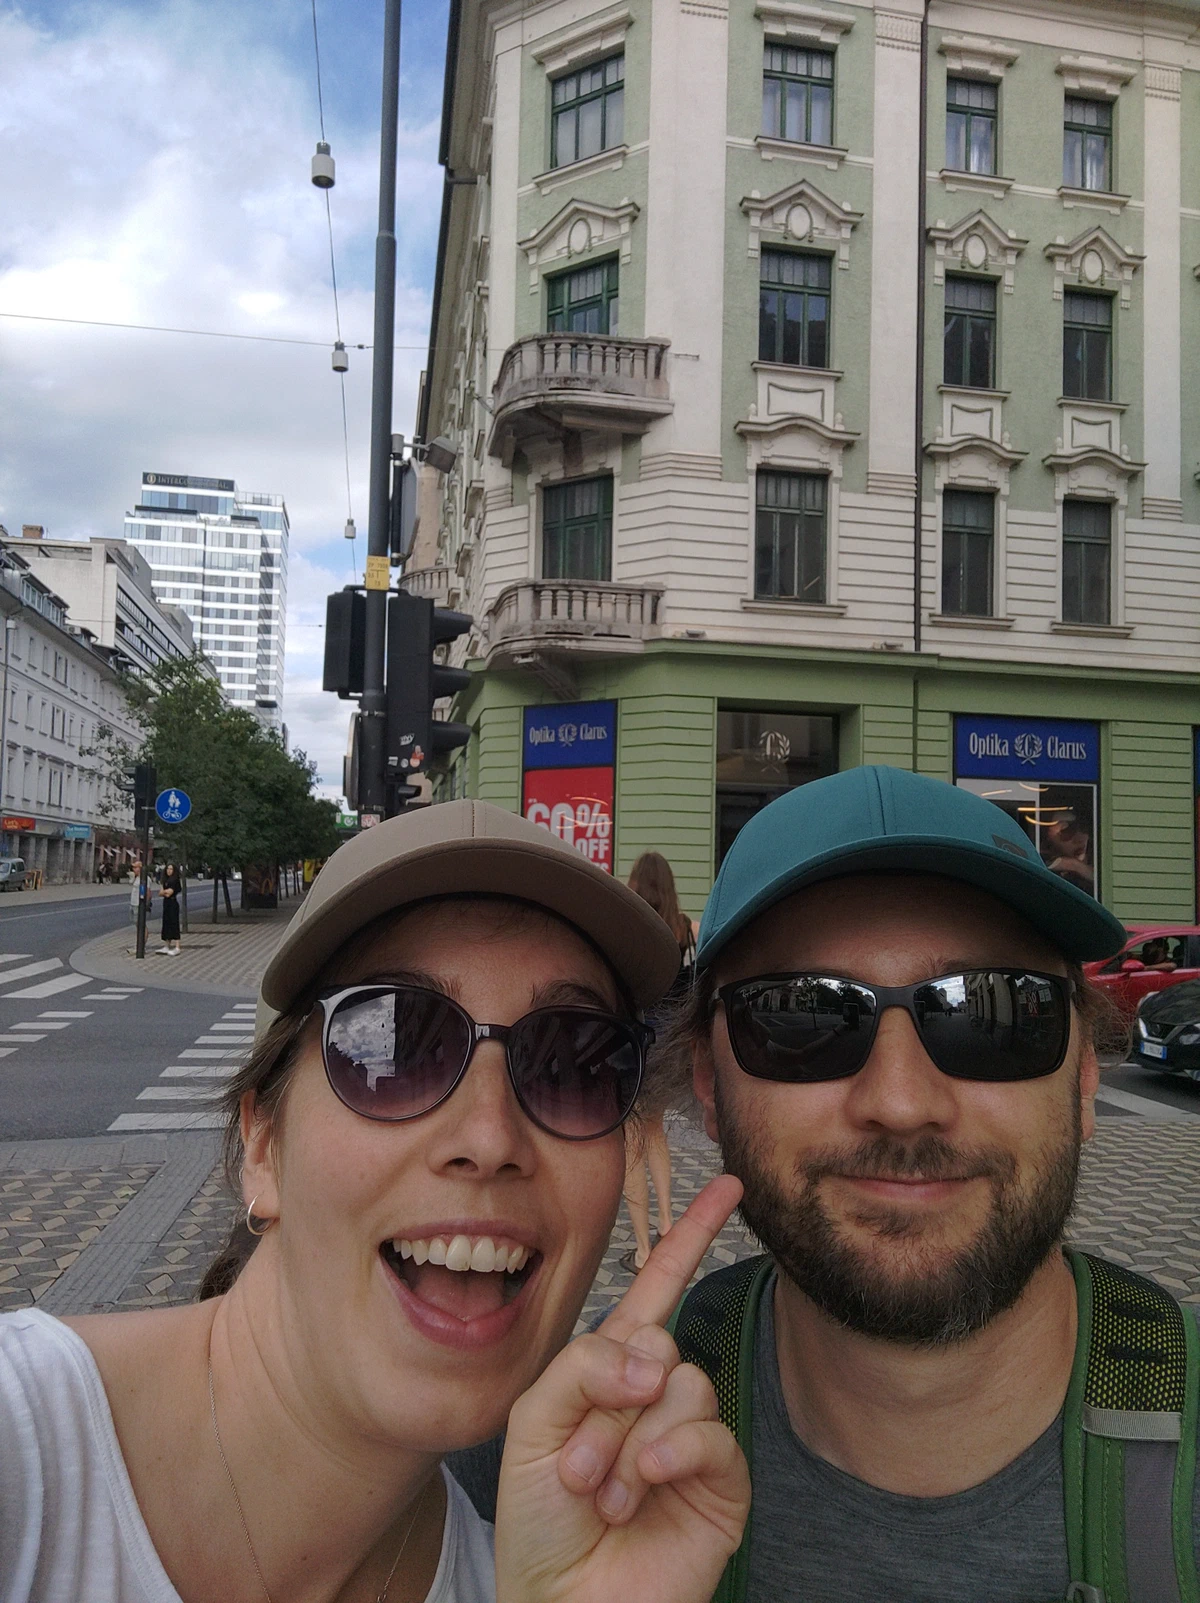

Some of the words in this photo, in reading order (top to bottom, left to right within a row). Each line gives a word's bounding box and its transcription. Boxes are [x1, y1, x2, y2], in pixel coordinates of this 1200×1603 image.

[529, 726, 556, 746] Optika
[580, 723, 607, 741] Clarus
[969, 732, 1010, 759] Optika
[1047, 735, 1087, 760] Clarus
[576, 838, 609, 859] OFF
